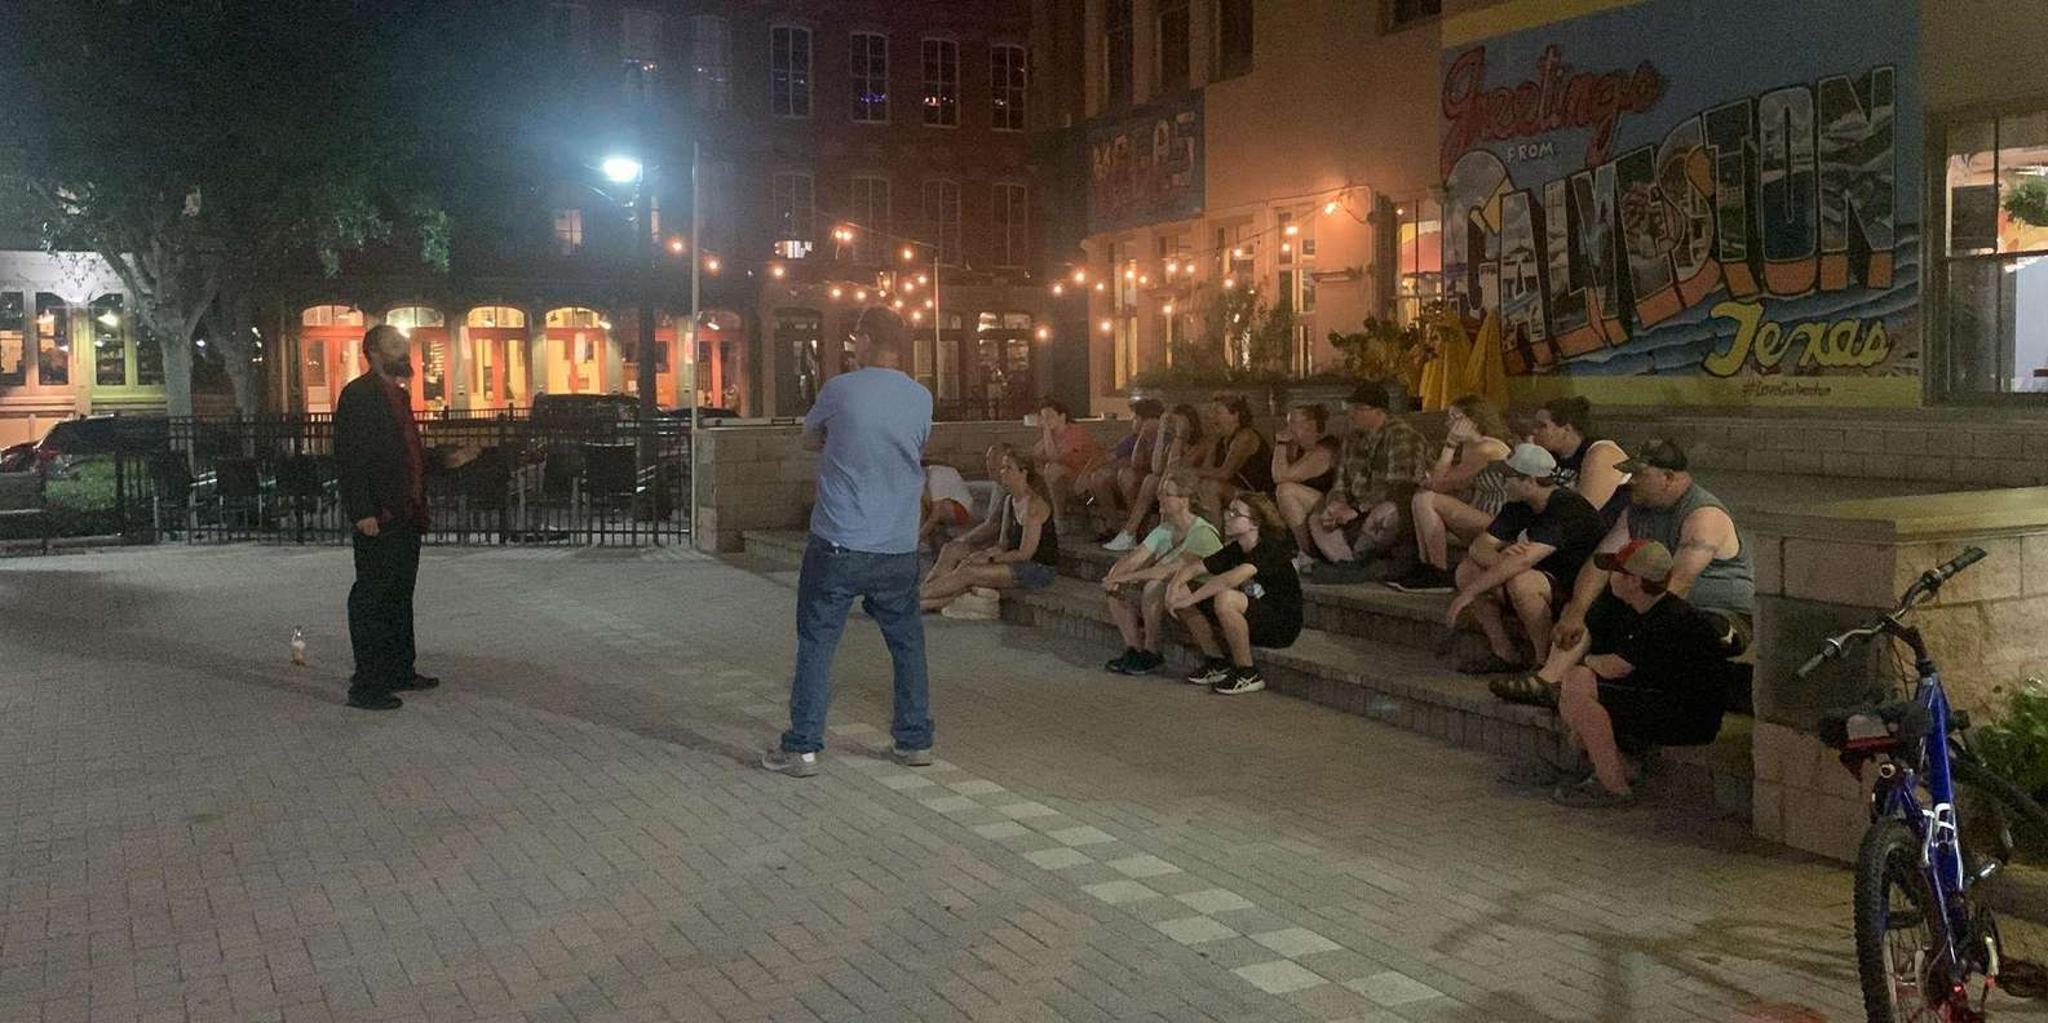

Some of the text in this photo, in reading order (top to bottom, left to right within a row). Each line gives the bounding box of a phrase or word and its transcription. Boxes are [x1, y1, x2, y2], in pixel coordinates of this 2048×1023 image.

[1441, 43, 1665, 182] Greetings
[1506, 141, 1555, 163] FROM
[1441, 64, 1898, 377] GALVESTON
[1701, 300, 1893, 378] Texas
